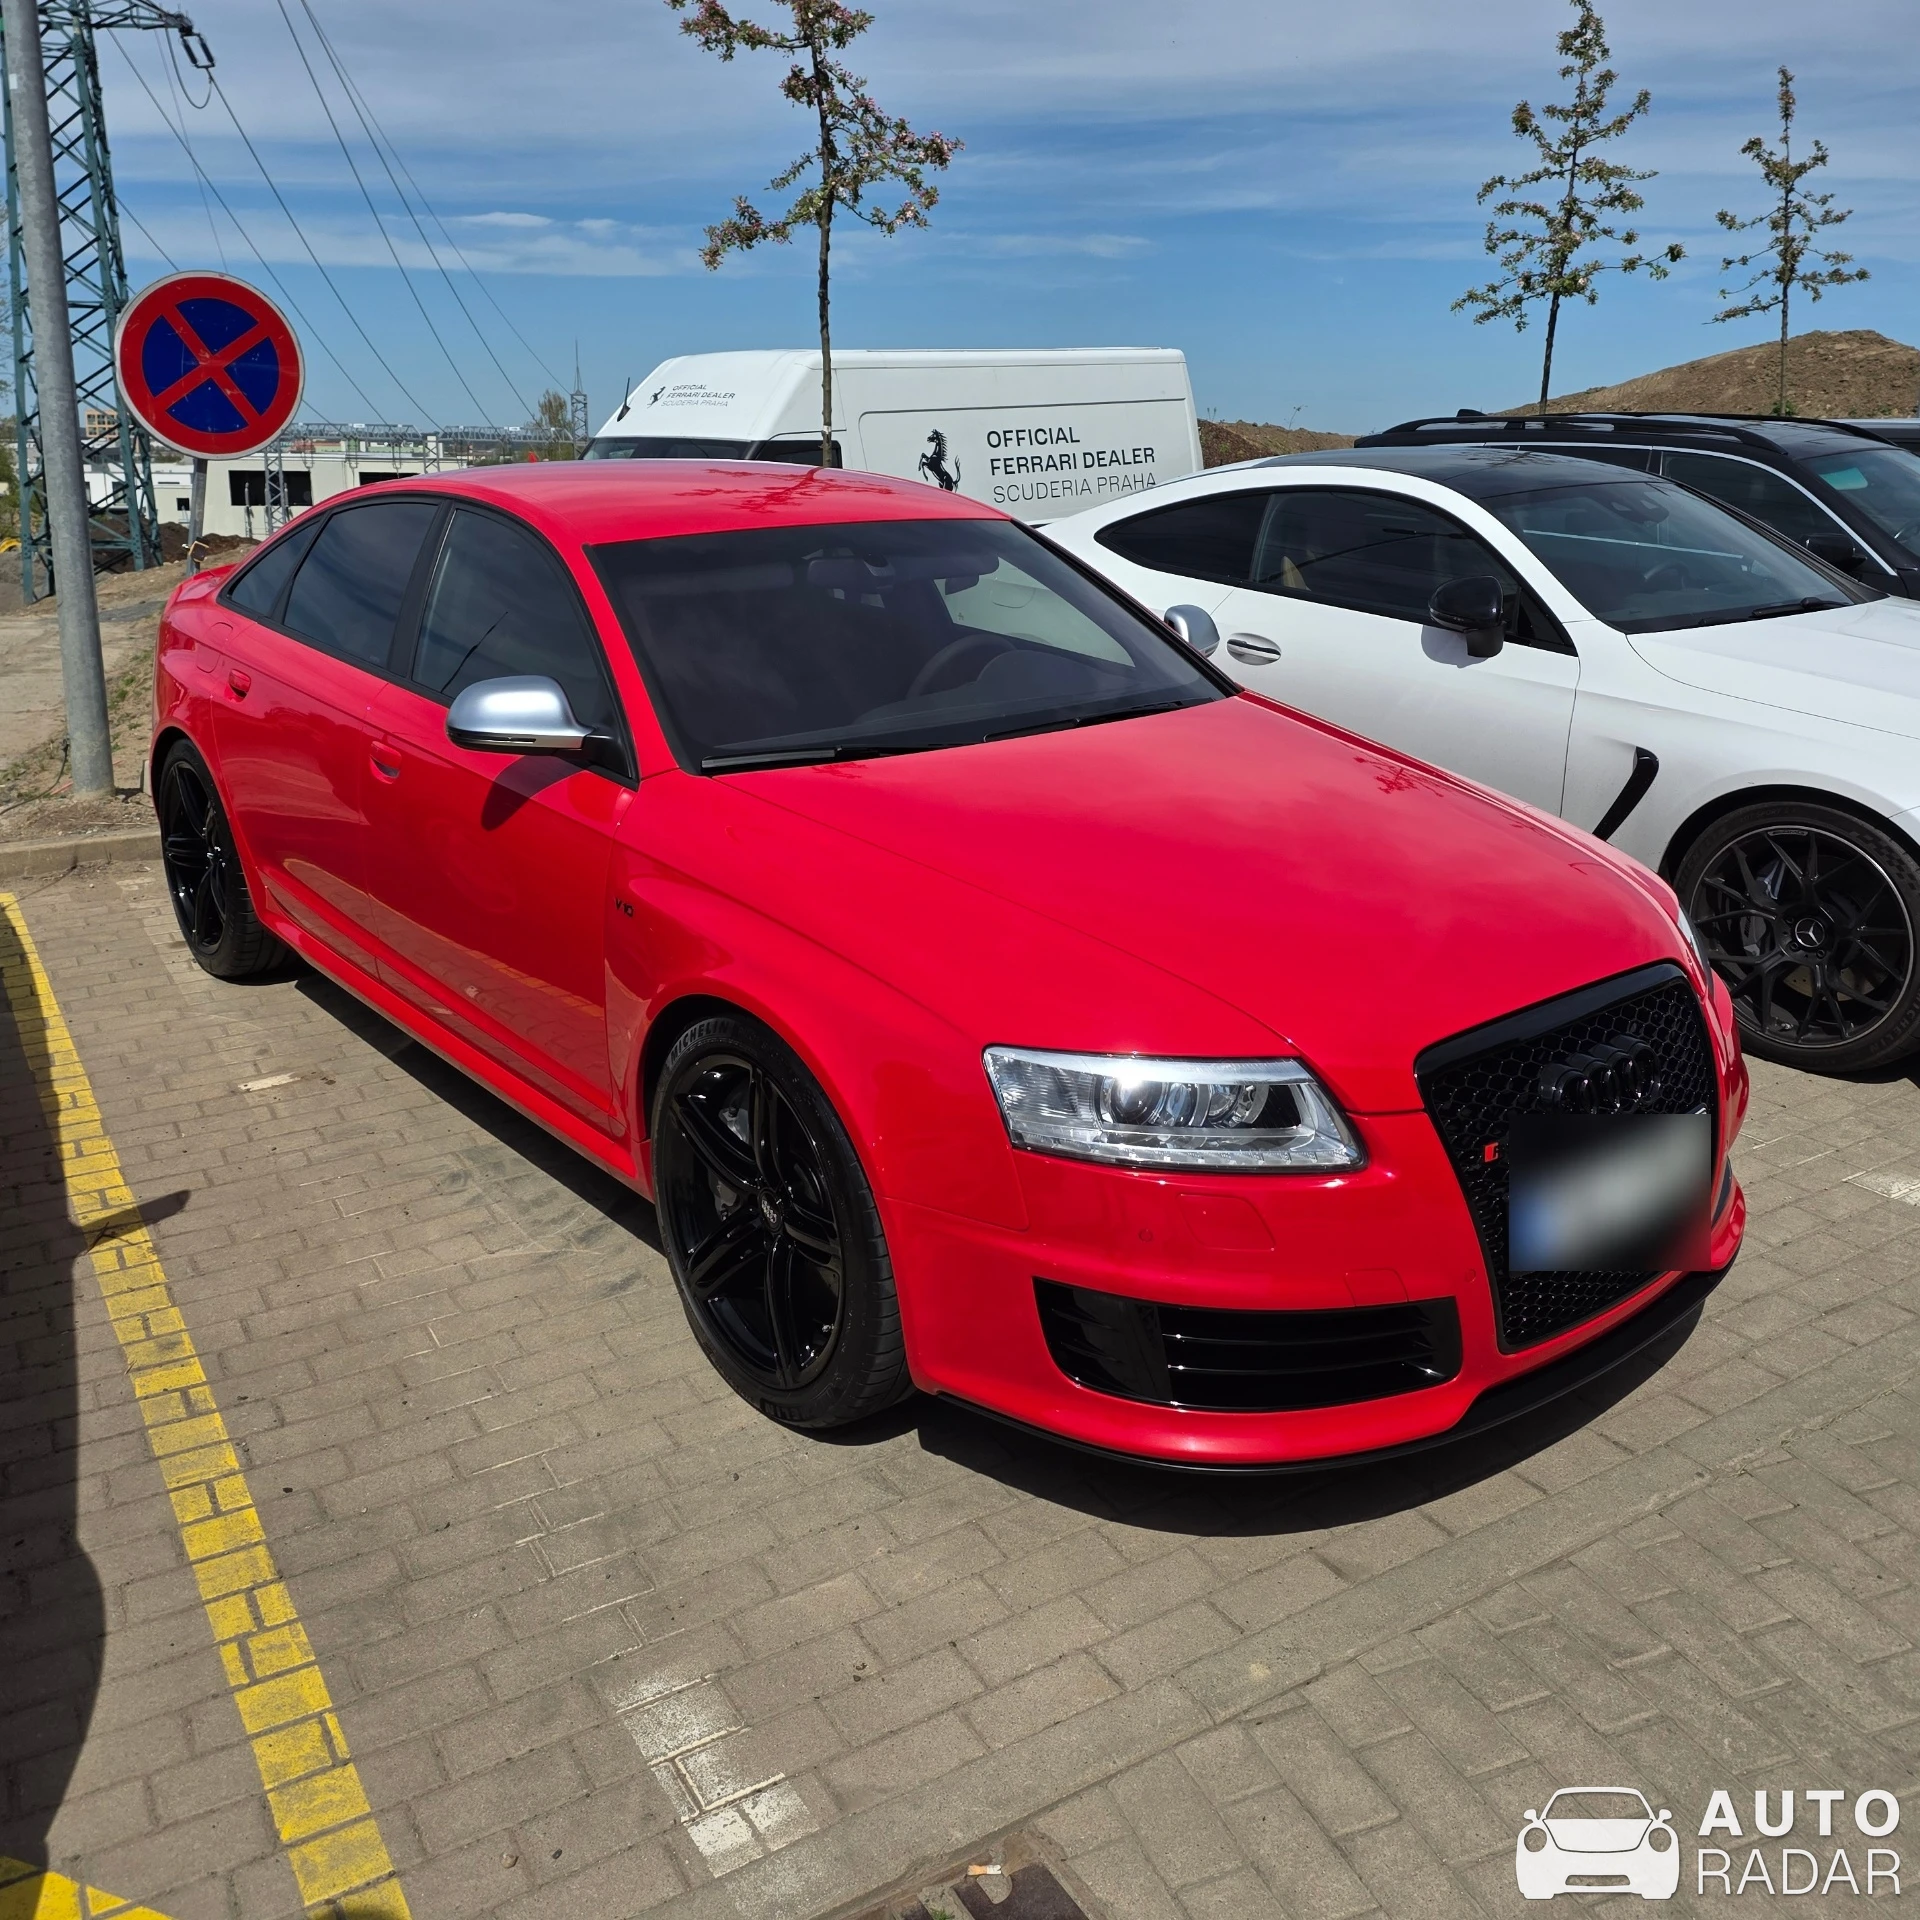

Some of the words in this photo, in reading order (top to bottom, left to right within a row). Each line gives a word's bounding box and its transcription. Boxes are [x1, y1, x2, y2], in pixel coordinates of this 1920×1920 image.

[661, 399, 699, 407] SCUDERIA
[700, 399, 729, 407] PRAHA
[666, 391, 700, 399] FERRARI
[701, 391, 736, 399] DEALER
[986, 426, 1081, 449] OFFICIAL
[990, 452, 1078, 476] FERRARI
[1082, 447, 1156, 469] DEALER
[993, 478, 1093, 504] SCUDERIA
[1097, 472, 1156, 494] PRAHA
[613, 896, 635, 918] V10
[670, 1019, 730, 1064] MICHELIN
